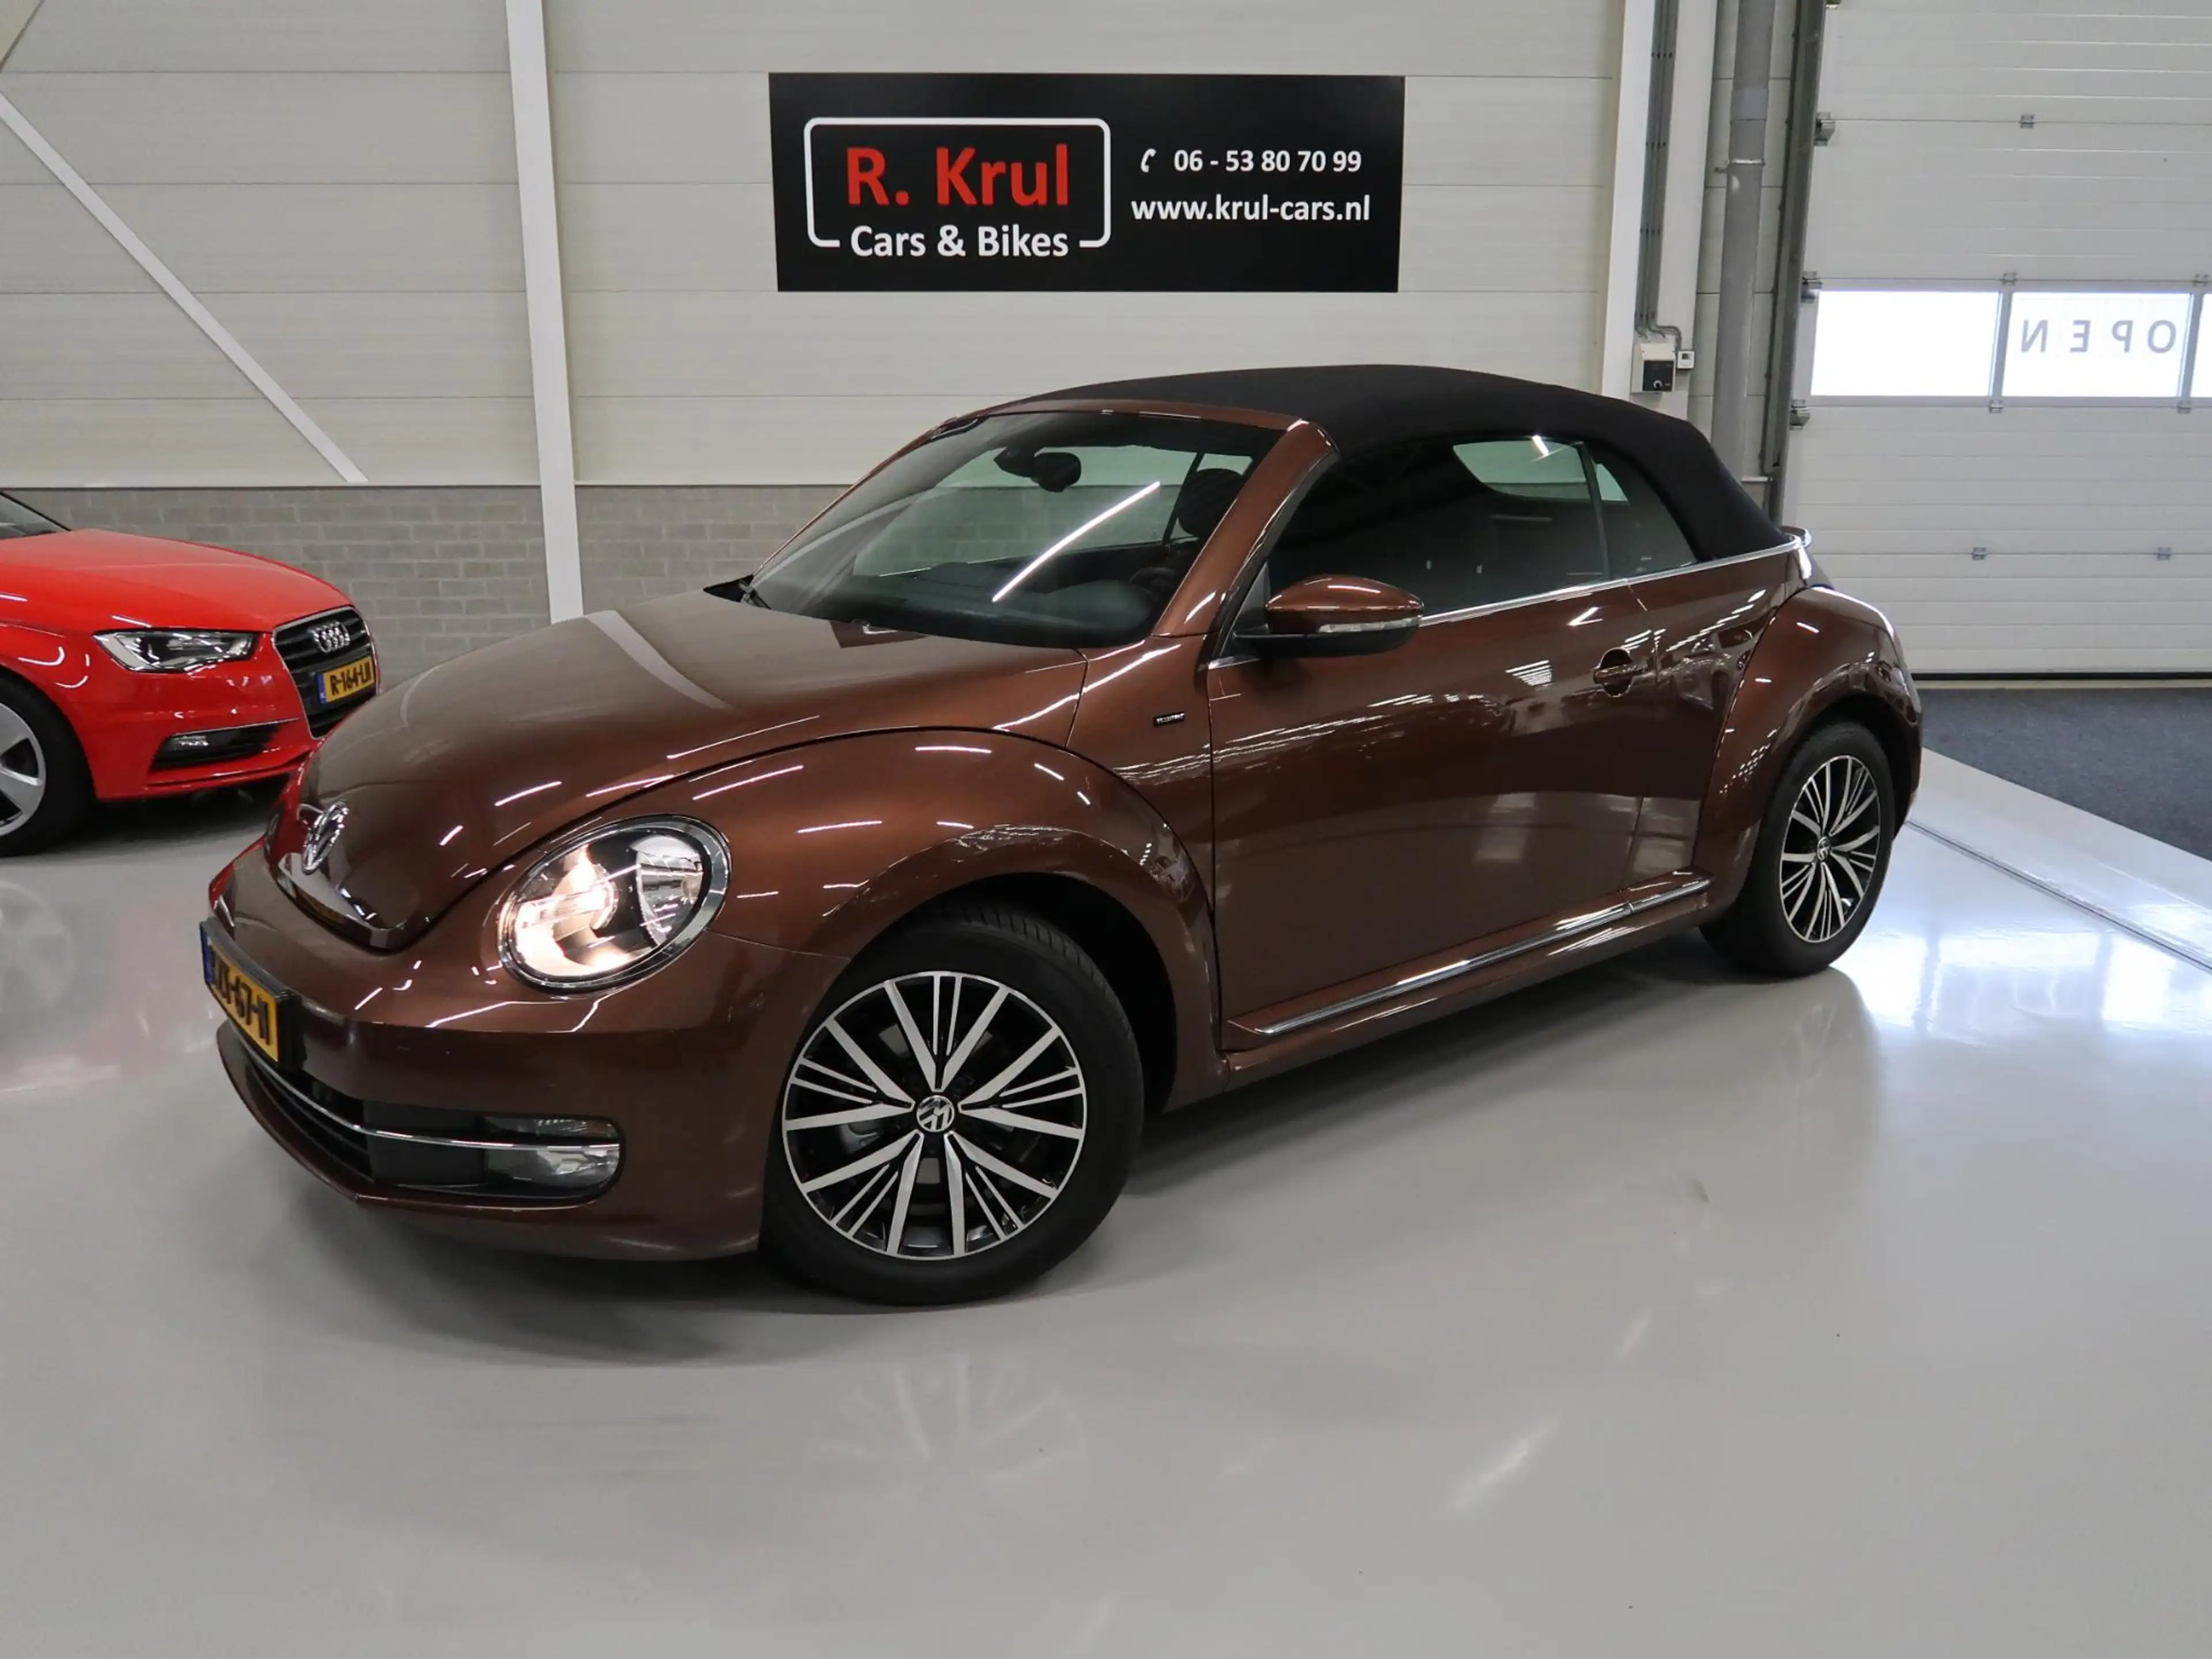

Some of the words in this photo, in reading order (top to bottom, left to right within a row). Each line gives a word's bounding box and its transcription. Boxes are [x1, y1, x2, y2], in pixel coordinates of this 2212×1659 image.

[847, 147, 909, 206] R.
[937, 144, 1068, 206] Krul
[1174, 149, 1203, 172] 06
[1225, 150, 1254, 172] 53
[1261, 150, 1290, 172] 80
[1297, 150, 1326, 172] 70
[1333, 150, 1362, 172] 99
[1131, 194, 1370, 221] www.krul-cars.nl
[851, 225, 926, 257] Cars
[937, 224, 966, 257] &
[978, 224, 1069, 257] Bikes
